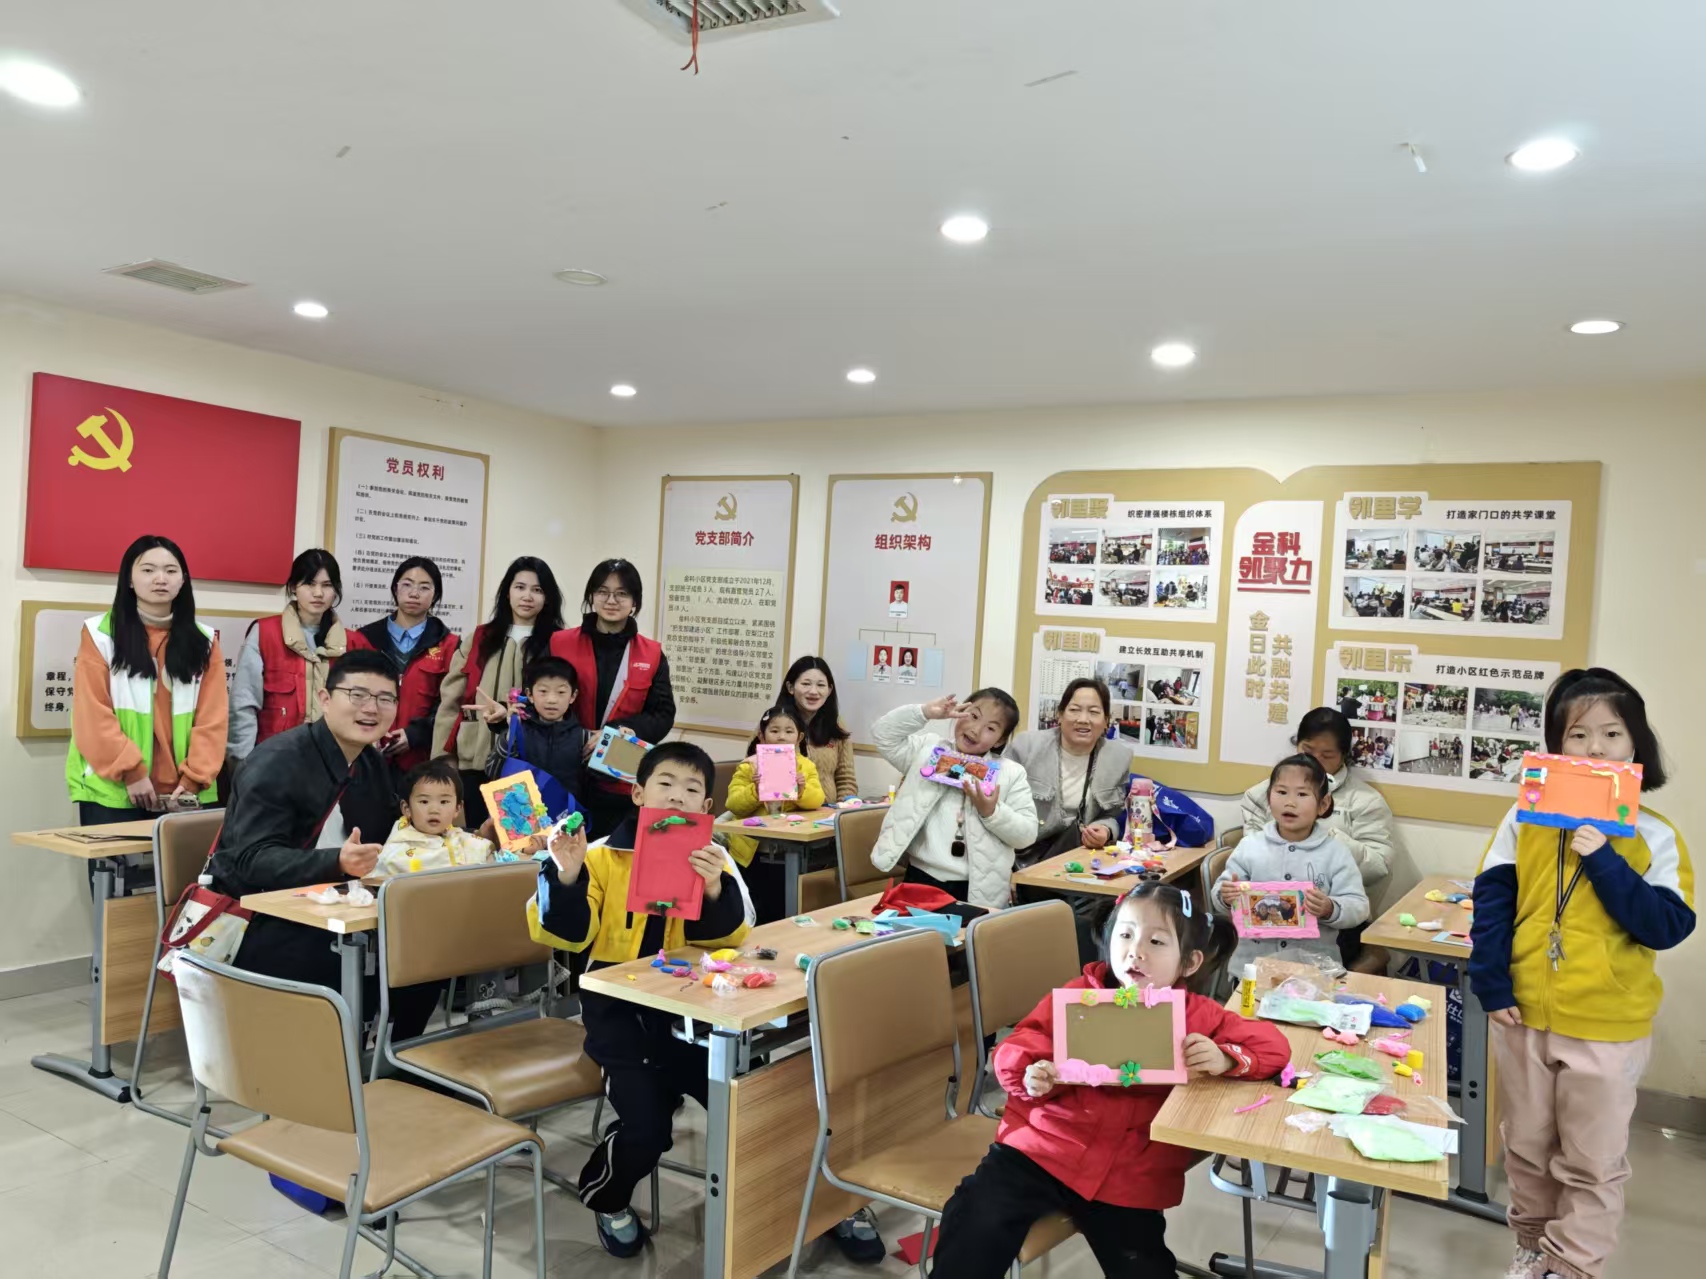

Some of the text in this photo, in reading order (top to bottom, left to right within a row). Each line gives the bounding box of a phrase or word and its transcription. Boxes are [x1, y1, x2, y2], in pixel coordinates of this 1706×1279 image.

[386, 457, 445, 481] 党员权利
[1127, 509, 1213, 519] 织密建强楼栋组织体系
[1349, 496, 1422, 520] 邻里学
[1446, 509, 1557, 520] 打造家门口的共学课堂
[695, 530, 755, 547] 党支部简介
[874, 534, 932, 551] 组织架构
[1251, 531, 1301, 556] 金科
[1238, 556, 1313, 585] 邻聚力
[1118, 645, 1204, 659] 建立长效互助共享机制
[1244, 609, 1270, 700] 金日此时
[1339, 647, 1413, 673] 邻里乐
[1267, 633, 1293, 726] 共融共建
[1435, 664, 1545, 681] 打造小区红色示范品牌
[44, 701, 69, 712] 终身，
